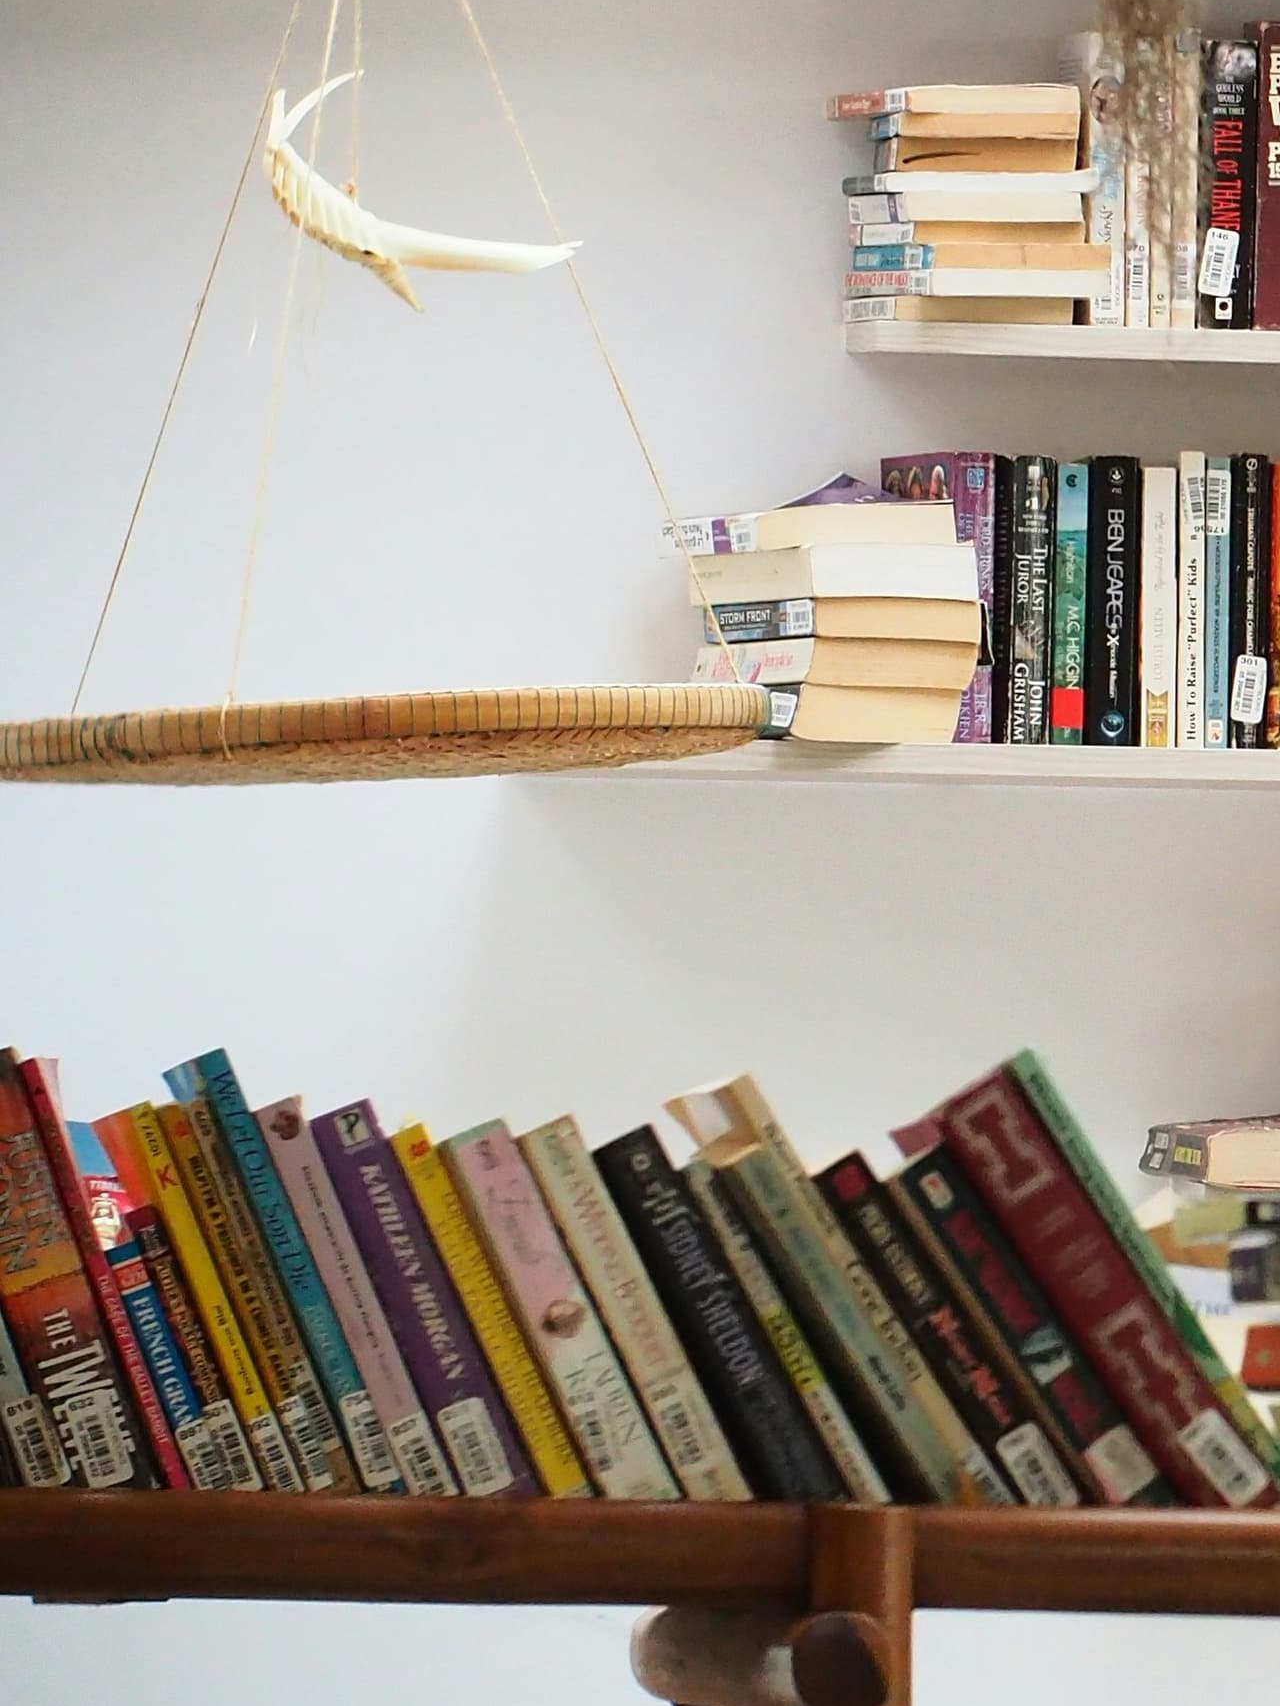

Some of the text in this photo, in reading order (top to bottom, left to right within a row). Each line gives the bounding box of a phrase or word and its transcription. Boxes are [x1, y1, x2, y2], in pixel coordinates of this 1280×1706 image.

[1211, 231, 1229, 240] 146
[1016, 554, 1030, 604] JUROR
[1032, 549, 1048, 612] THE LAST
[1105, 508, 1124, 629] BEN JEAPES
[1188, 557, 1199, 586] Kids
[719, 609, 772, 625] STORM FRONT
[1187, 653, 1198, 687] Raise
[1012, 662, 1029, 741] GRISHAM
[1028, 679, 1043, 726] JOHN
[1187, 691, 1197, 707] To
[1186, 711, 1197, 740] How
[360, 1163, 469, 1384] KATHLEEN MORGAN
[132, 1295, 176, 1375] FRENCH
